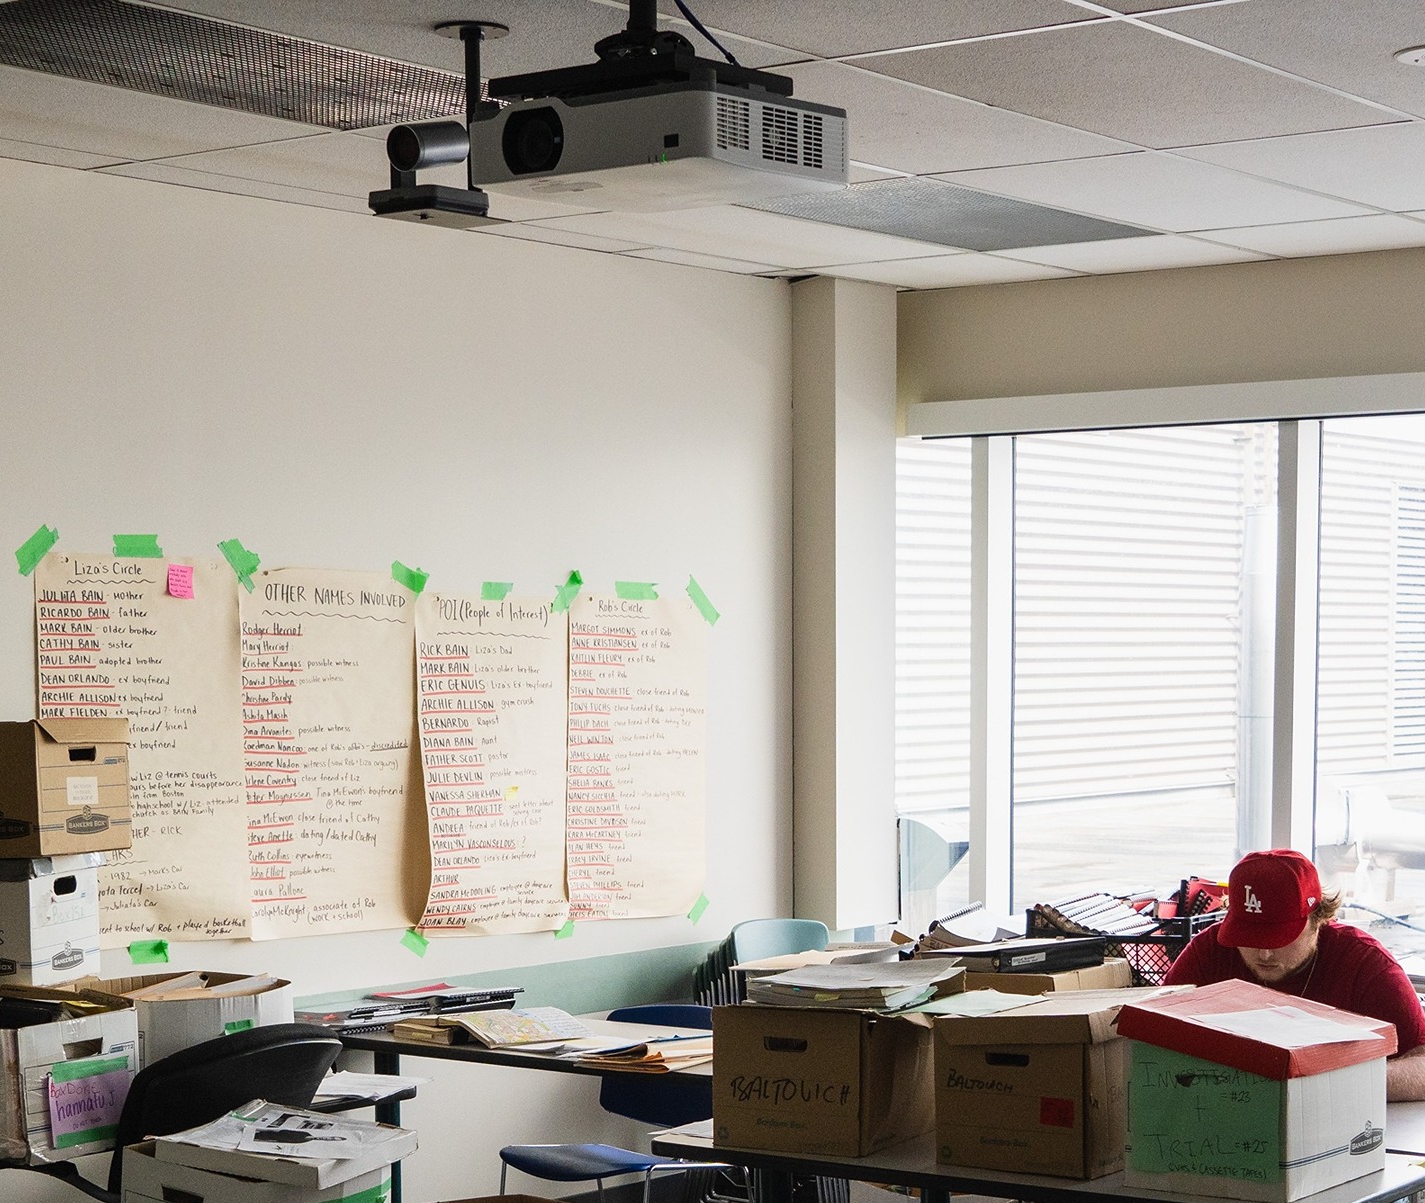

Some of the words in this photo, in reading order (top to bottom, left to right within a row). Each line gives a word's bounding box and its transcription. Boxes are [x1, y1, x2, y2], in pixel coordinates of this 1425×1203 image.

[74, 560, 110, 575] Liza's
[113, 564, 142, 575] Circle
[81, 591, 103, 602] BAIN
[265, 584, 306, 602] OTHER
[315, 588, 355, 606] NAMES
[360, 590, 406, 607] INVOLVED
[40, 607, 82, 619] RICARDO
[88, 608, 109, 619] BAIN
[118, 608, 148, 618] father
[496, 603, 505, 619] of
[509, 602, 550, 625] Interest)
[599, 602, 619, 613] Rob's
[622, 603, 643, 614] Circle
[40, 623, 67, 635] MARK
[70, 624, 93, 635] BAIN
[103, 625, 126, 635] older
[129, 627, 157, 636] brother
[572, 623, 599, 634] MARGOT
[602, 627, 636, 636] SIMMONS
[40, 639, 74, 650] CATHY
[78, 639, 100, 650] BAIN
[108, 641, 132, 650] sister
[421, 644, 444, 657] RICK
[446, 645, 468, 657] BAIN
[40, 655, 62, 665] PAUL
[67, 655, 93, 665] BAIN
[99, 657, 131, 667] adopted
[307, 659, 333, 670] possible
[336, 659, 359, 667] witness
[421, 662, 445, 674] MARK
[446, 662, 469, 674] BAIN
[41, 674, 66, 684] DEAN
[68, 674, 109, 684] ORLANDO
[133, 675, 170, 686] boyfriend
[242, 675, 266, 686] David
[421, 679, 443, 691] ERIC
[42, 693, 75, 702] ARCHIE
[79, 693, 117, 703] ALLISON
[421, 698, 451, 709] ARCHIE
[456, 698, 494, 709] ALLISON
[42, 708, 66, 718] MARK
[70, 708, 108, 718] FIELDEN
[423, 717, 469, 730] BERNARDO
[424, 737, 450, 748] DIANA
[453, 738, 474, 747] BAIN
[426, 754, 456, 765] FATHER
[459, 754, 483, 765] SCOTT
[266, 774, 296, 786] Coventry
[427, 771, 451, 783] JULIE
[454, 771, 483, 782] DEVLIN
[369, 787, 403, 798] boyfriend
[429, 789, 463, 802] VANESSA
[463, 788, 501, 800] SHERMAN
[431, 805, 463, 816] CLAUDE
[466, 804, 503, 816] PAQUETTE
[161, 826, 182, 837] RICK
[434, 823, 464, 833] ANDREA
[433, 840, 464, 851] MARILYN
[267, 850, 291, 862] Collins
[434, 857, 452, 866] DEAN
[453, 856, 480, 865] ORLANDO
[111, 871, 131, 881] 1982
[434, 874, 459, 883] ARTHUR
[114, 883, 143, 896] Tercel
[275, 885, 304, 896] Pallone
[431, 890, 459, 900] SANDRA
[1244, 884, 1262, 914] LA
[54, 956, 70, 966] BANKERS
[730, 1076, 850, 1106] BALTOVICH
[1144, 1133, 1234, 1160] TRIAL
[1350, 1136, 1372, 1151] BANKERS
[1372, 1134, 1382, 1144] BOX
[1198, 1164, 1239, 1176] CASSETTE
